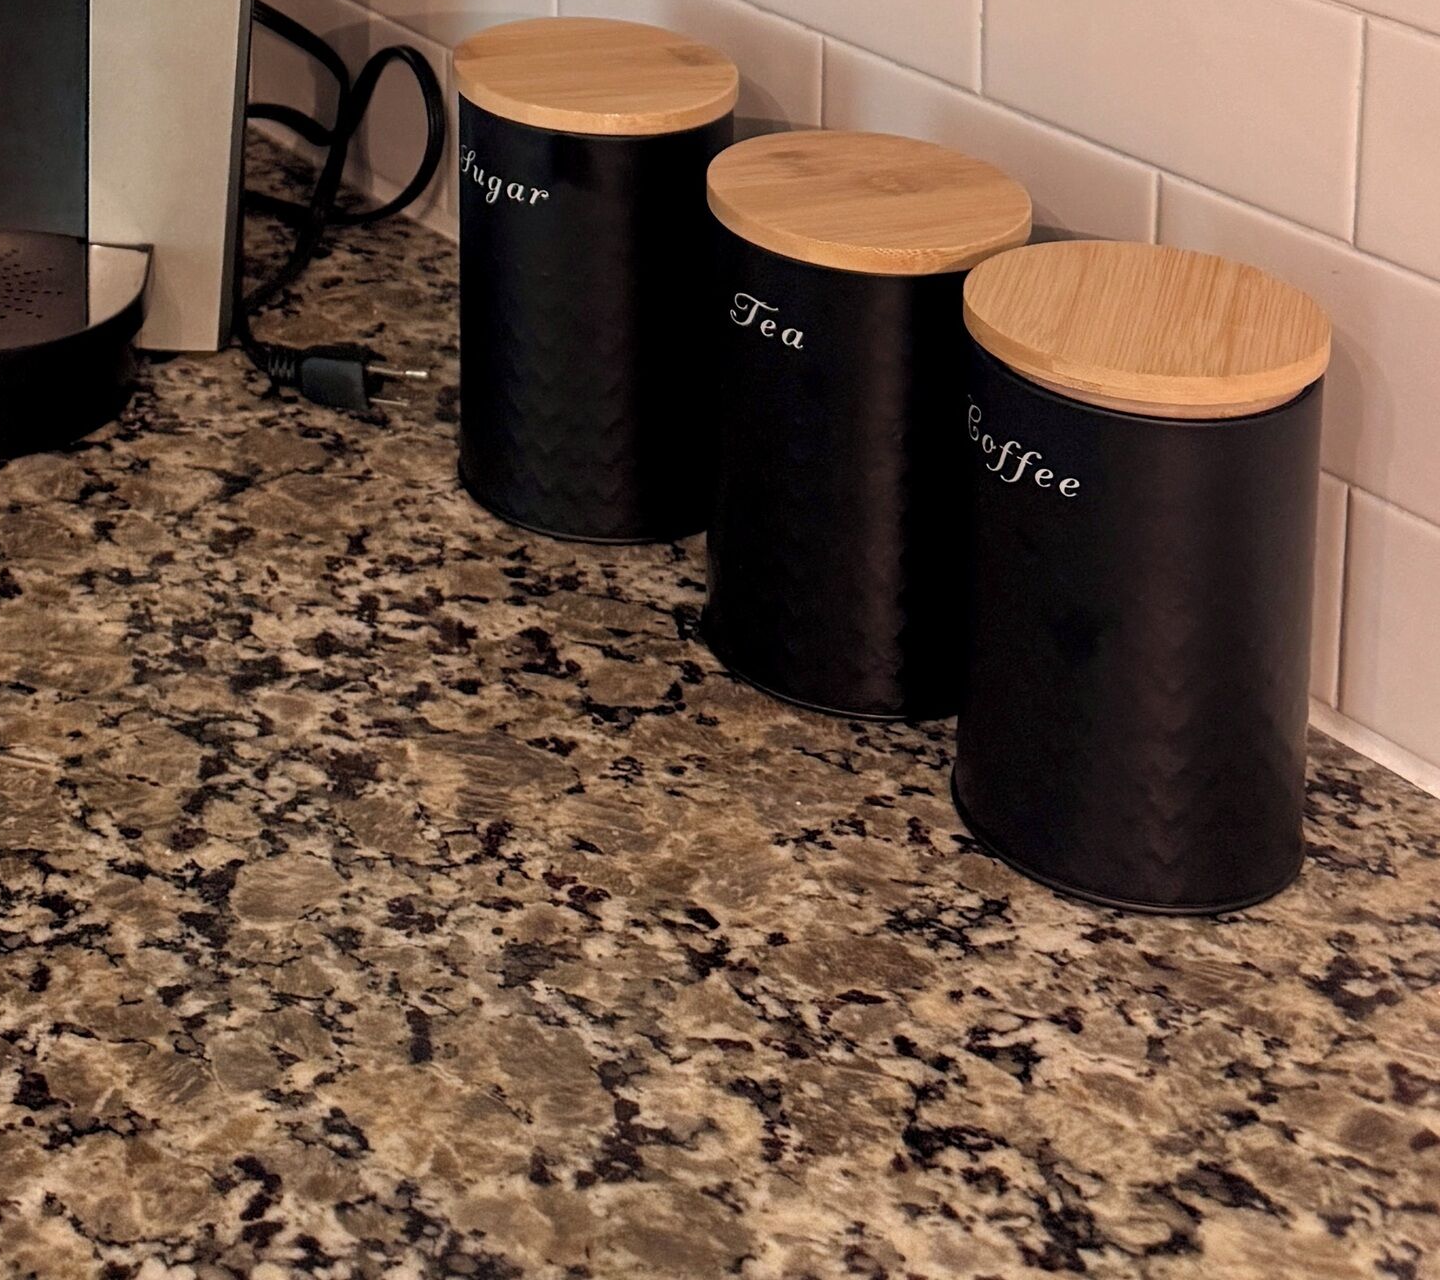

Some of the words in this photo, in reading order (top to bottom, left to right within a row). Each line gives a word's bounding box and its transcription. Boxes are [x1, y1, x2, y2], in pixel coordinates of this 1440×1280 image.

[461, 144, 550, 205] Sugar
[730, 292, 804, 350] Tea
[967, 394, 1080, 498] Coffee
